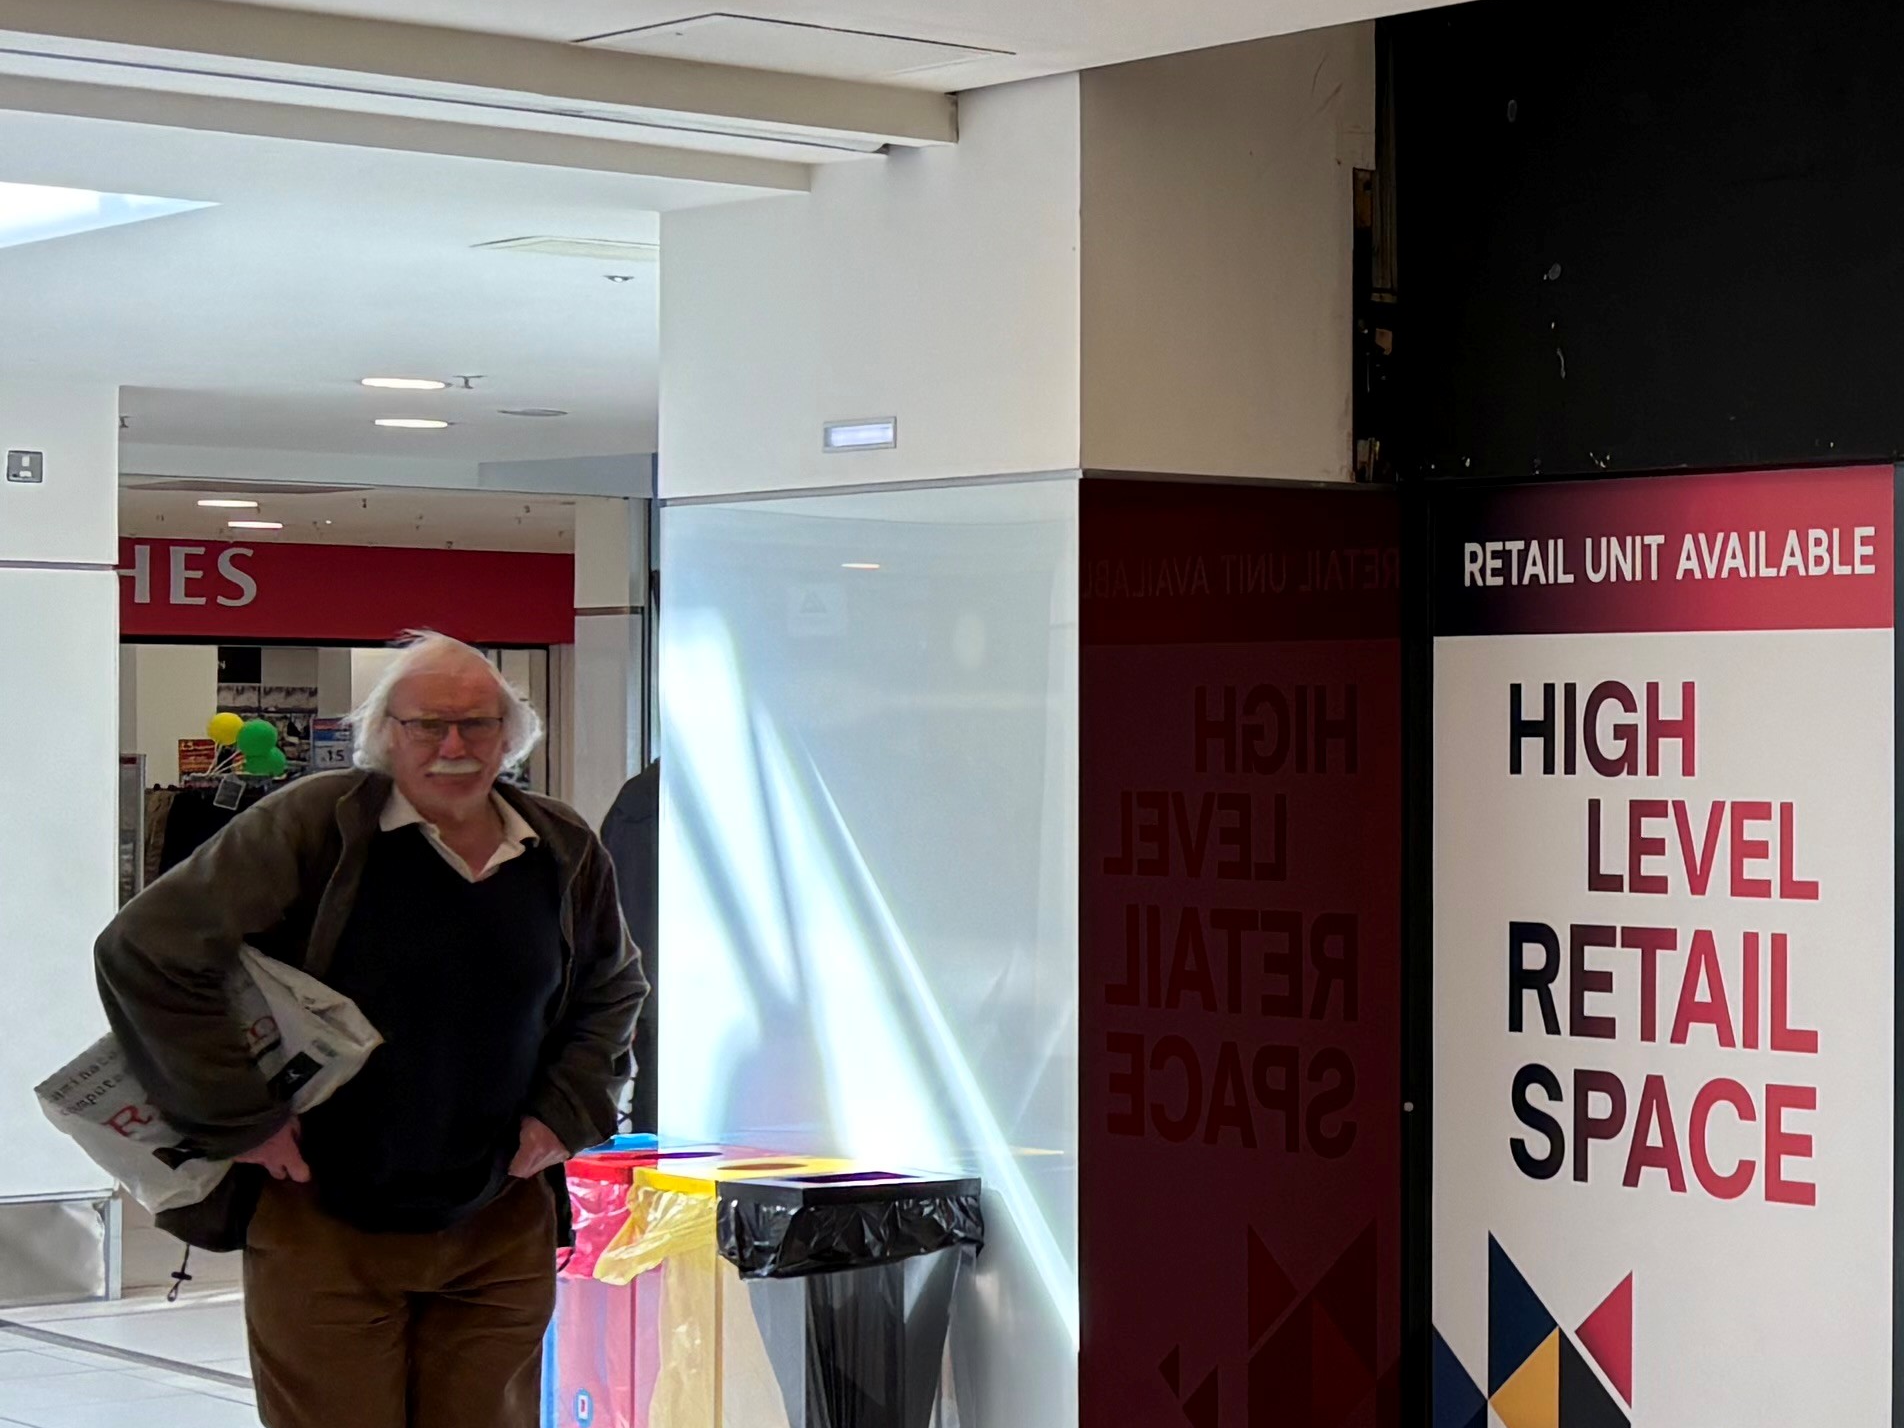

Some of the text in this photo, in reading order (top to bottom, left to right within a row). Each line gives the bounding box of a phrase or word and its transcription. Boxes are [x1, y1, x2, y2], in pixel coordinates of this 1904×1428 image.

[1465, 527, 1876, 587] RETAIL UNIT AVAILABLE
[1509, 680, 1695, 778] HIGH
[1587, 798, 1819, 901] LEVEL
[1508, 920, 1819, 1054] RETAIL
[1509, 1062, 1817, 1206] SPACE
